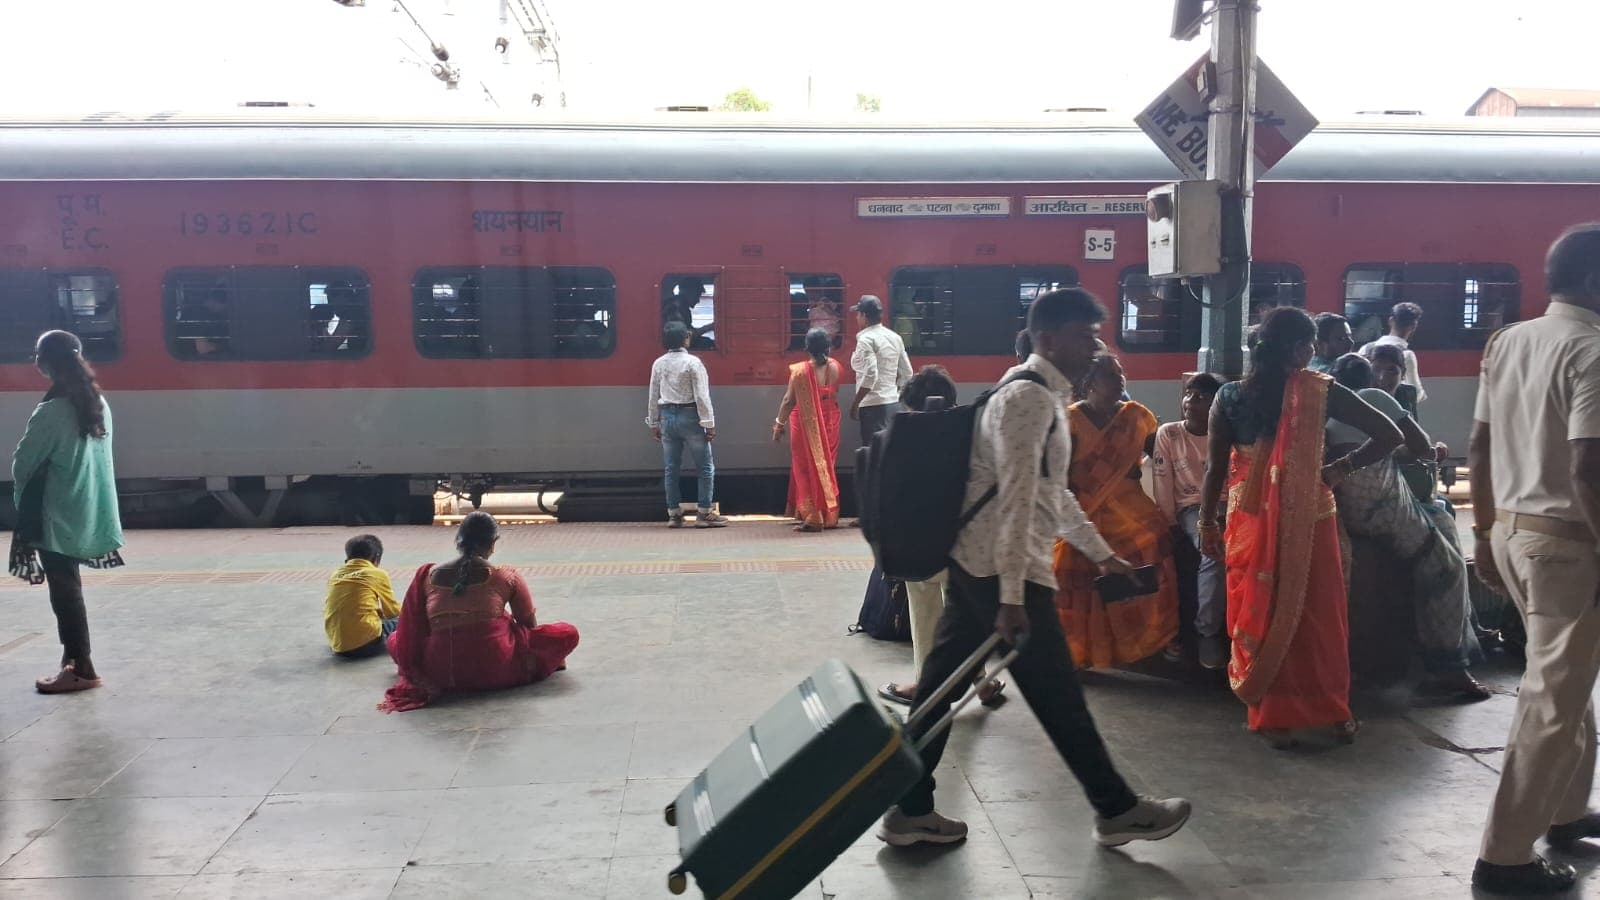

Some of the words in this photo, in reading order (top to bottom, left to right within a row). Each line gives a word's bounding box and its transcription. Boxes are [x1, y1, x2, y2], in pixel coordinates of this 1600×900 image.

[868, 203, 904, 214] धनबाद
[926, 203, 953, 213] पटना
[972, 203, 1001, 214] दुमका
[1030, 200, 1088, 213] आरक्षित
[472, 209, 564, 233] शयनयान
[1087, 236, 1112, 252] S-5
